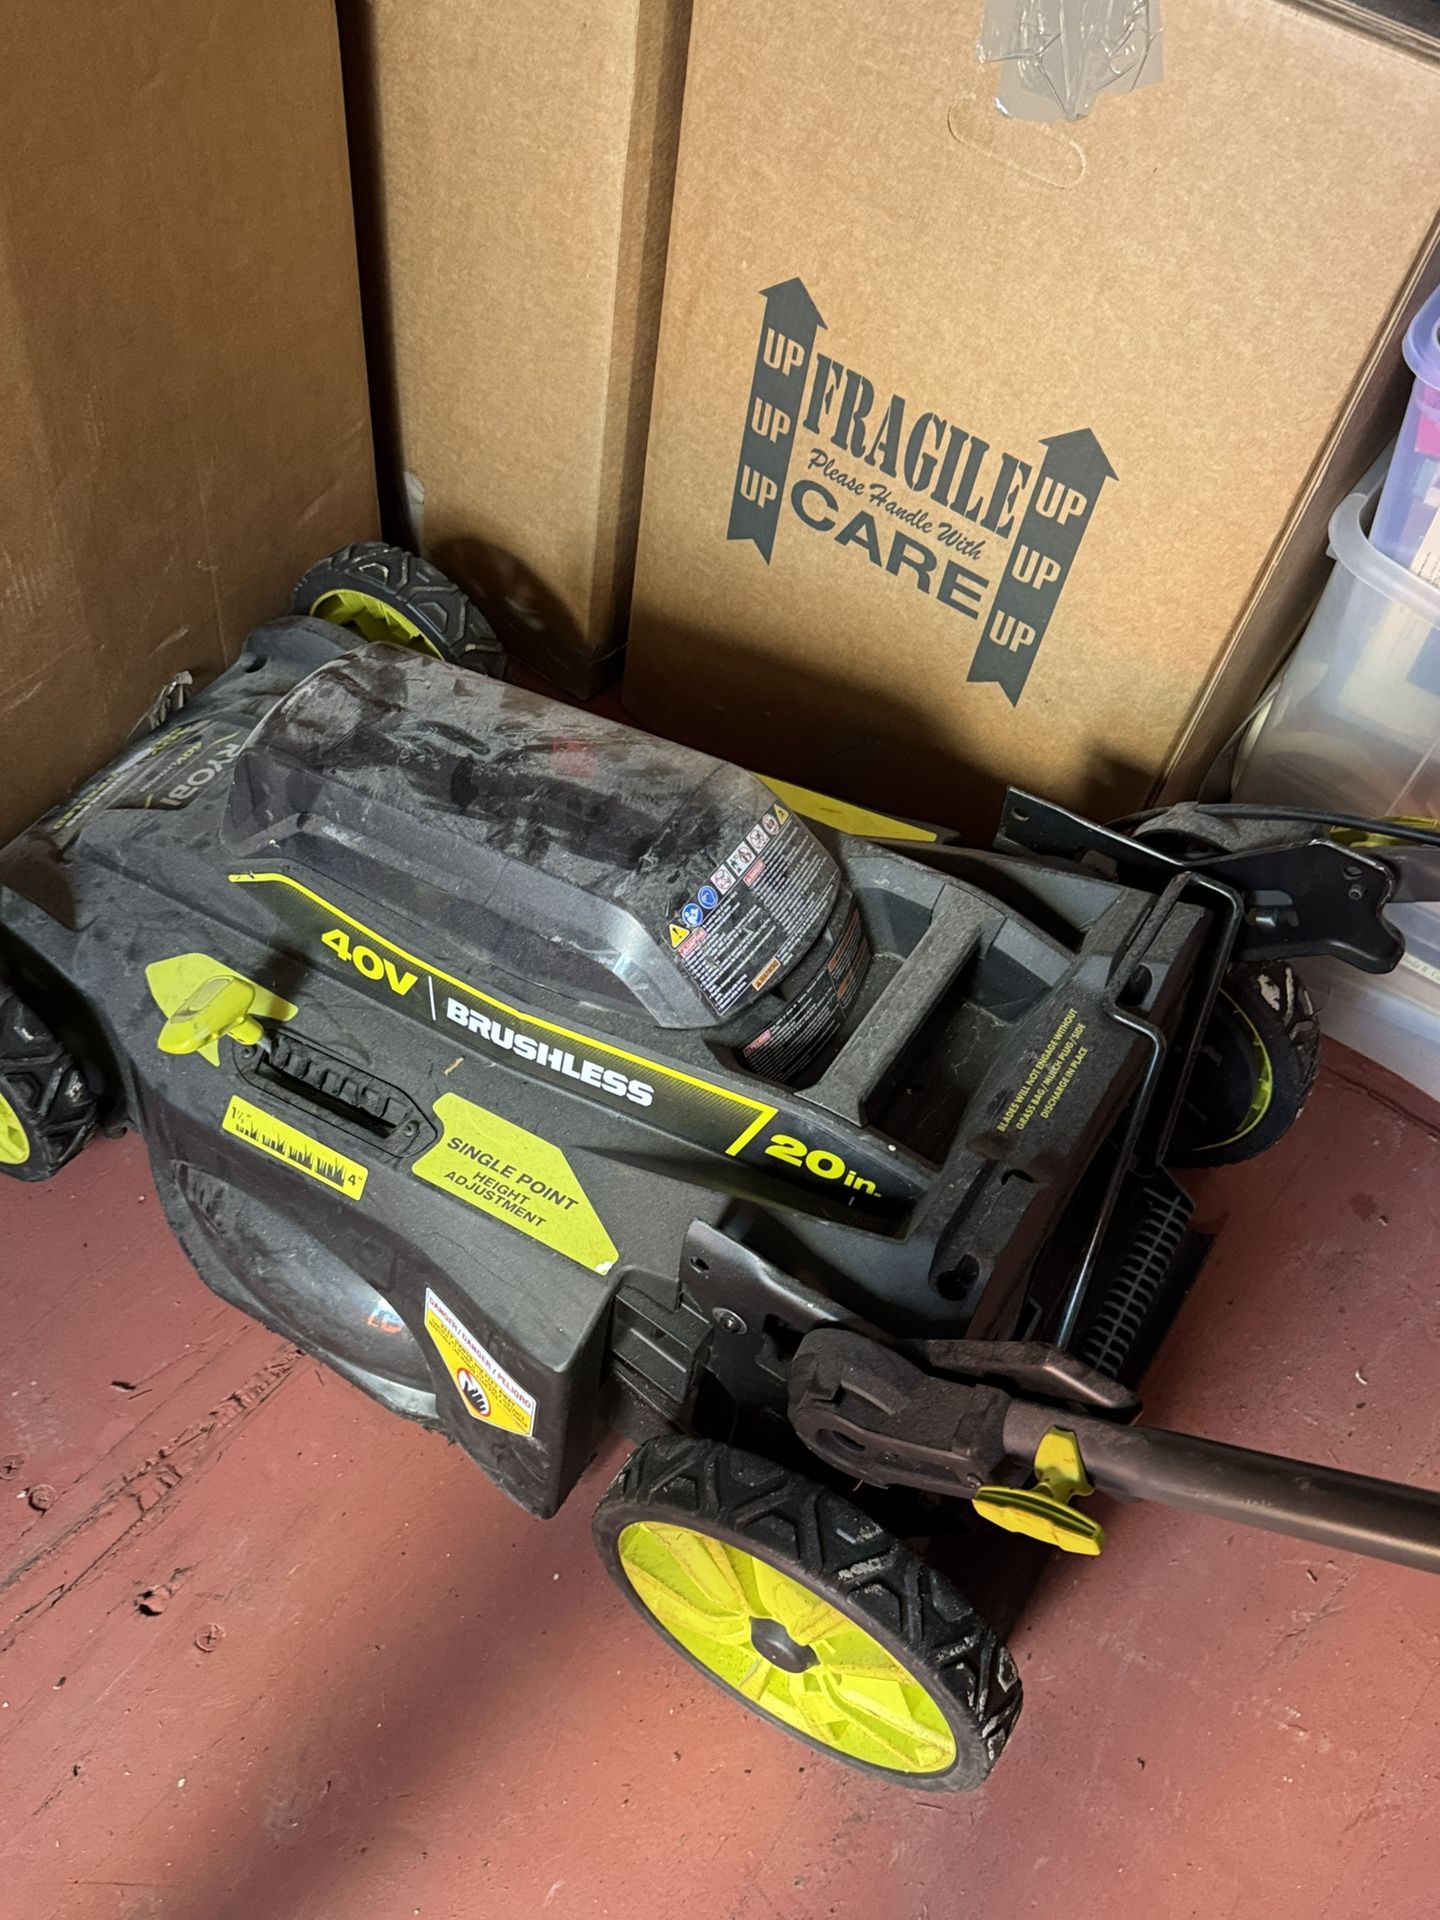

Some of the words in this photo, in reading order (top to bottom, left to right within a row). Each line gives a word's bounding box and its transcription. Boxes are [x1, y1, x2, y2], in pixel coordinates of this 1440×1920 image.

[763, 327, 805, 376] UP
[751, 397, 791, 443] UP
[802, 353, 1033, 539] FRAGILE
[740, 464, 778, 508] UP
[808, 448, 864, 496] Please
[869, 483, 934, 534] Handle
[937, 522, 983, 561] With
[1035, 477, 1088, 526] UP
[790, 479, 991, 620] CARE
[1011, 544, 1062, 591] UP
[989, 610, 1036, 653] UP
[160, 743, 240, 806] RYOBI
[321, 928, 418, 996] 40V
[447, 997, 655, 1107] BRUSHLESS
[996, 1102, 1019, 1132] BLADES
[1014, 1082, 1030, 1104] WILL
[1025, 1069, 1040, 1087] NOT
[1035, 1038, 1056, 1071] ENGAGE
[1053, 1008, 1078, 1042] WITHOUT
[1065, 1067, 1076, 1079] IN
[1070, 1046, 1088, 1069] PLACE
[1016, 1102, 1037, 1131] GRASS
[1040, 1077, 1069, 1119] DISCHARGE
[447, 1137, 516, 1179] SINGLE
[515, 1171, 579, 1210] POINT
[472, 1171, 530, 1205] HEIGHT
[443, 1170, 547, 1227] ADJUSTMENT
[461, 1332, 492, 1369] DANGER
[497, 1370, 531, 1409] PELIGRO
